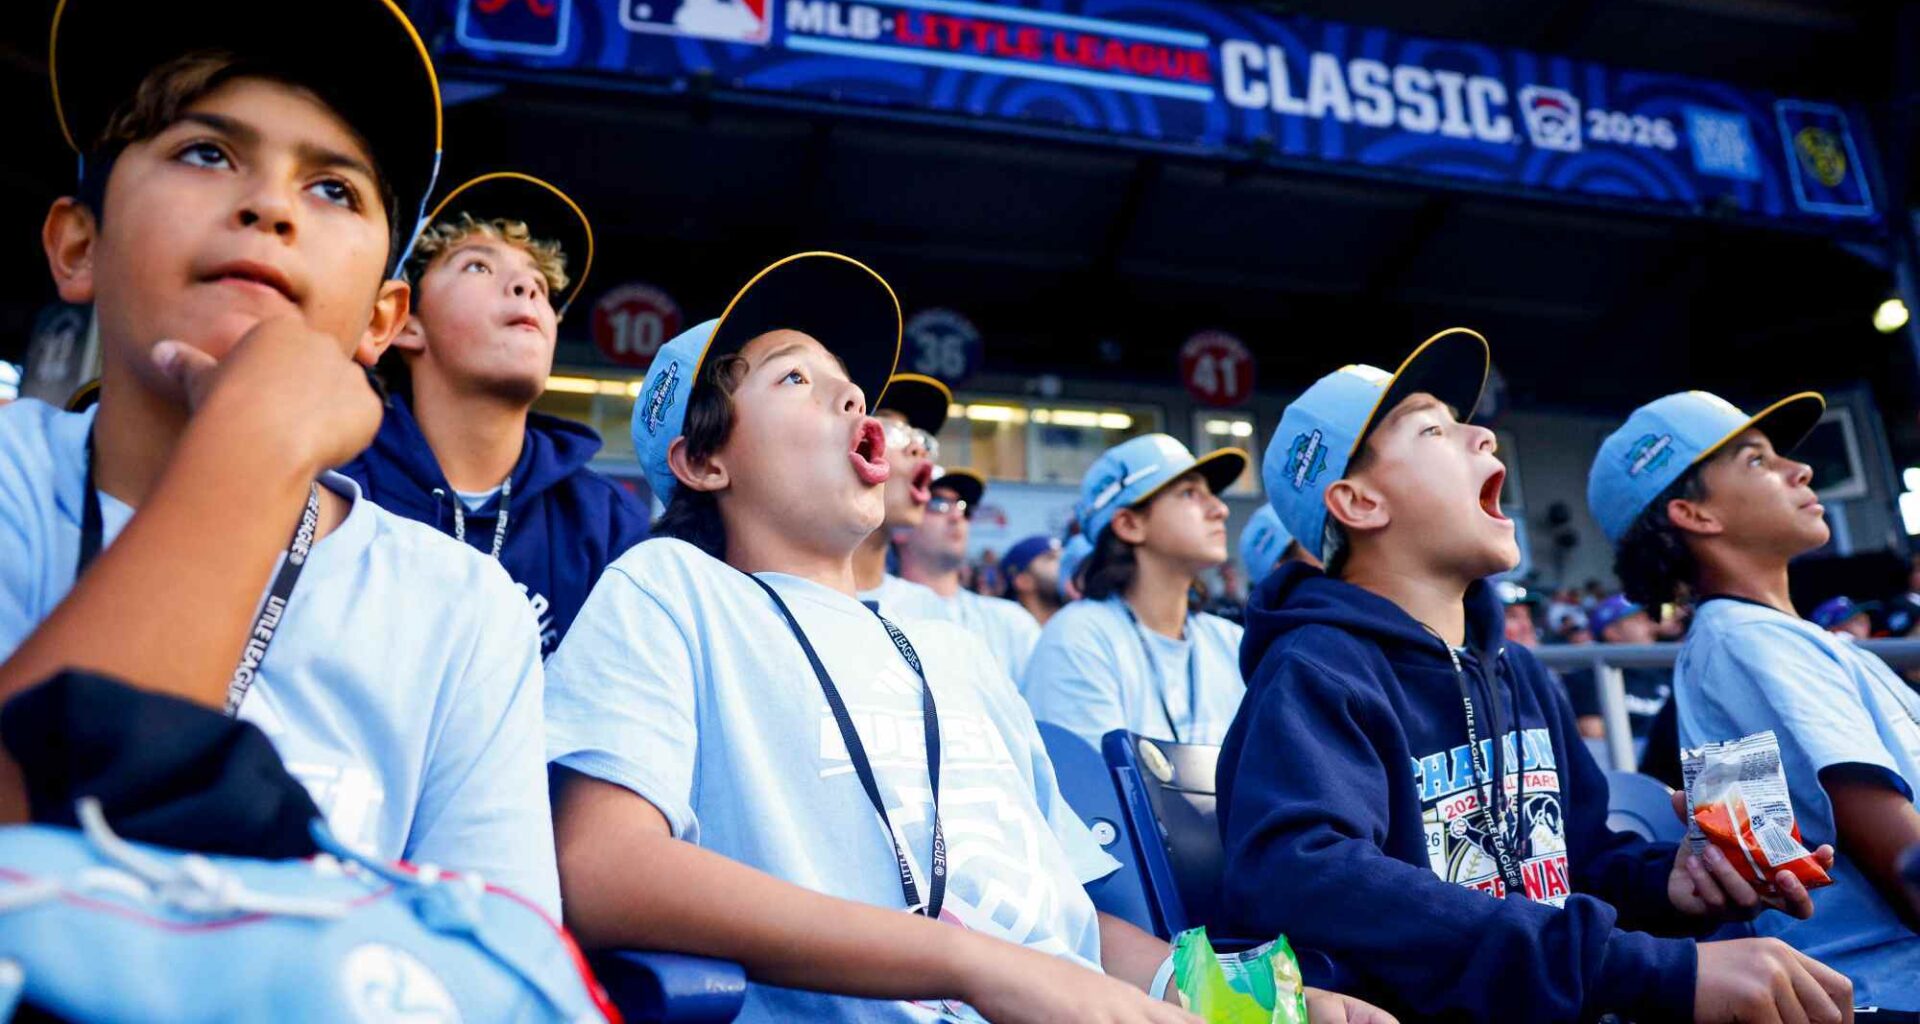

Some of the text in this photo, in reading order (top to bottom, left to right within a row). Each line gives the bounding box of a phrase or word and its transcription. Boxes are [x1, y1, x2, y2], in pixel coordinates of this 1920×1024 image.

[786, 0, 1212, 83] MLB LITTLE LEAGUE
[1220, 39, 1514, 144] CLASSIC
[1585, 108, 1678, 150] 2026
[608, 310, 663, 356] 10
[1193, 354, 1237, 398] 41
[256, 595, 286, 638] LITTLE
[1463, 697, 1475, 726] LITTLE
[1444, 794, 1489, 819] 202
[1482, 806, 1498, 833] LITTLE
